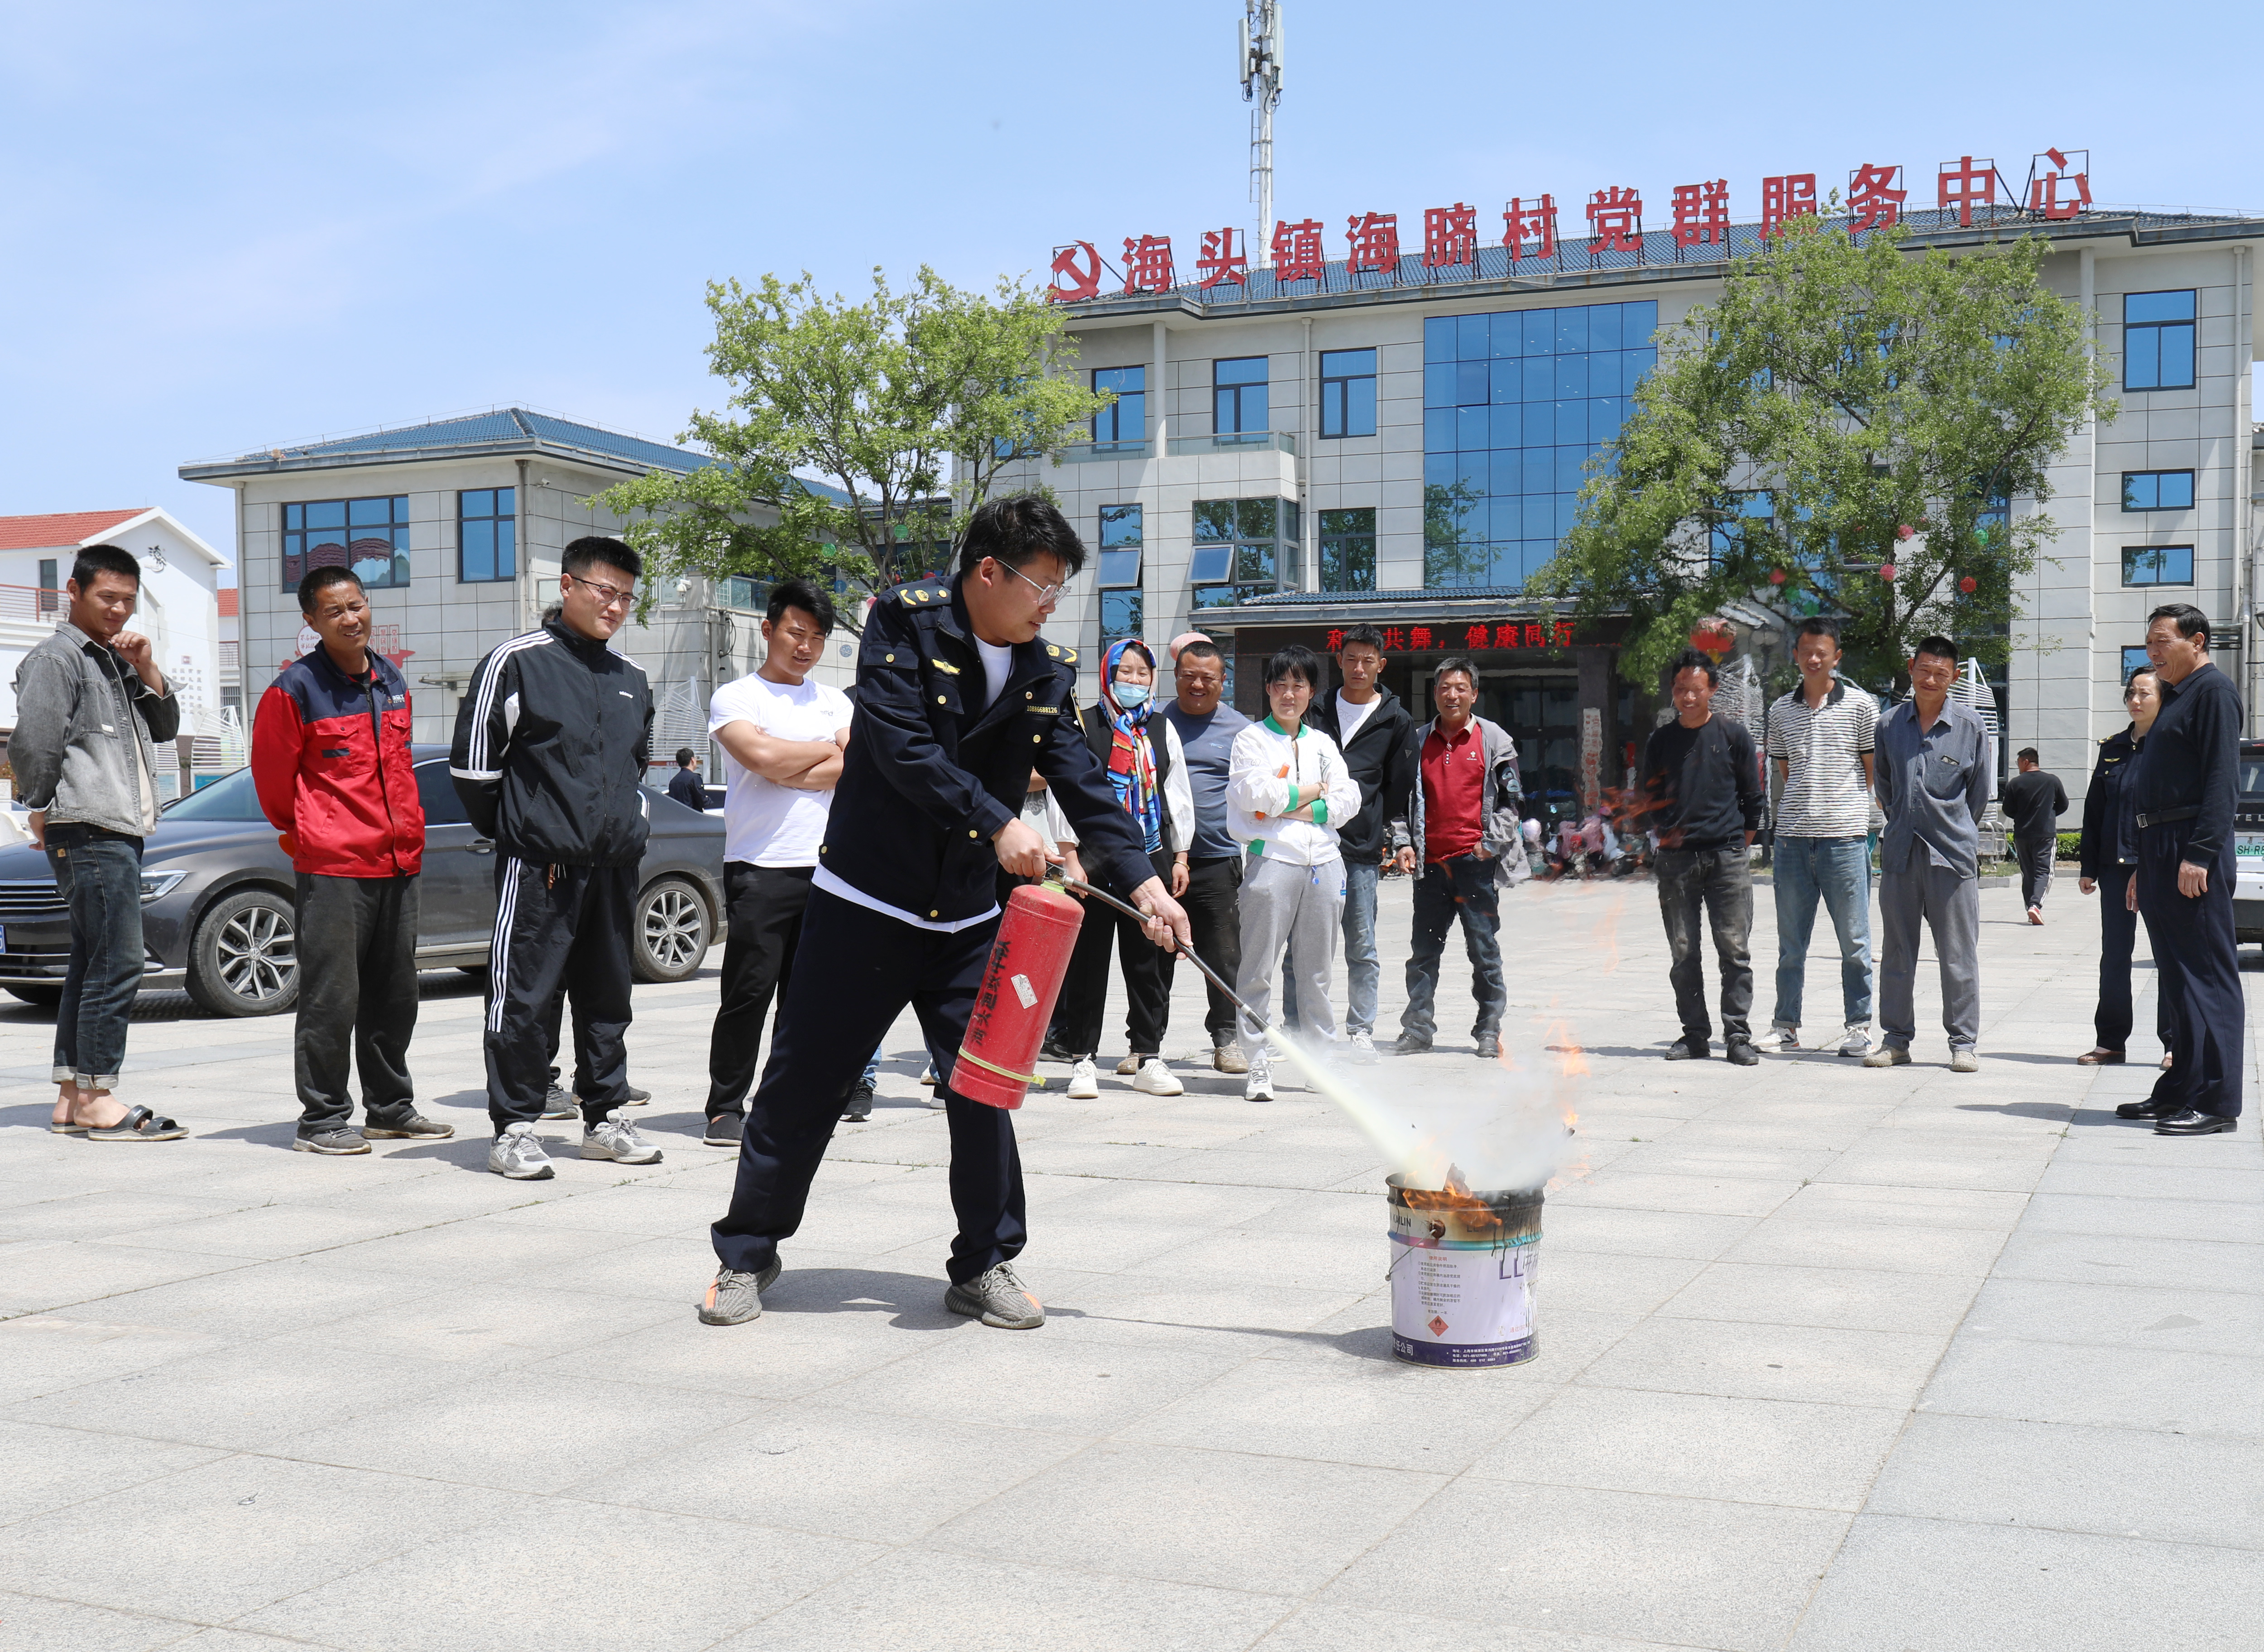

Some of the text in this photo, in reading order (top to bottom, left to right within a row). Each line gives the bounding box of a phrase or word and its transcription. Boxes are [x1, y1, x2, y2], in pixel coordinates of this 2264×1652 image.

[1121, 146, 2092, 295] 海头镇海脐村党群服务中心
[1327, 621, 1575, 651] 和共舞，健康同行
